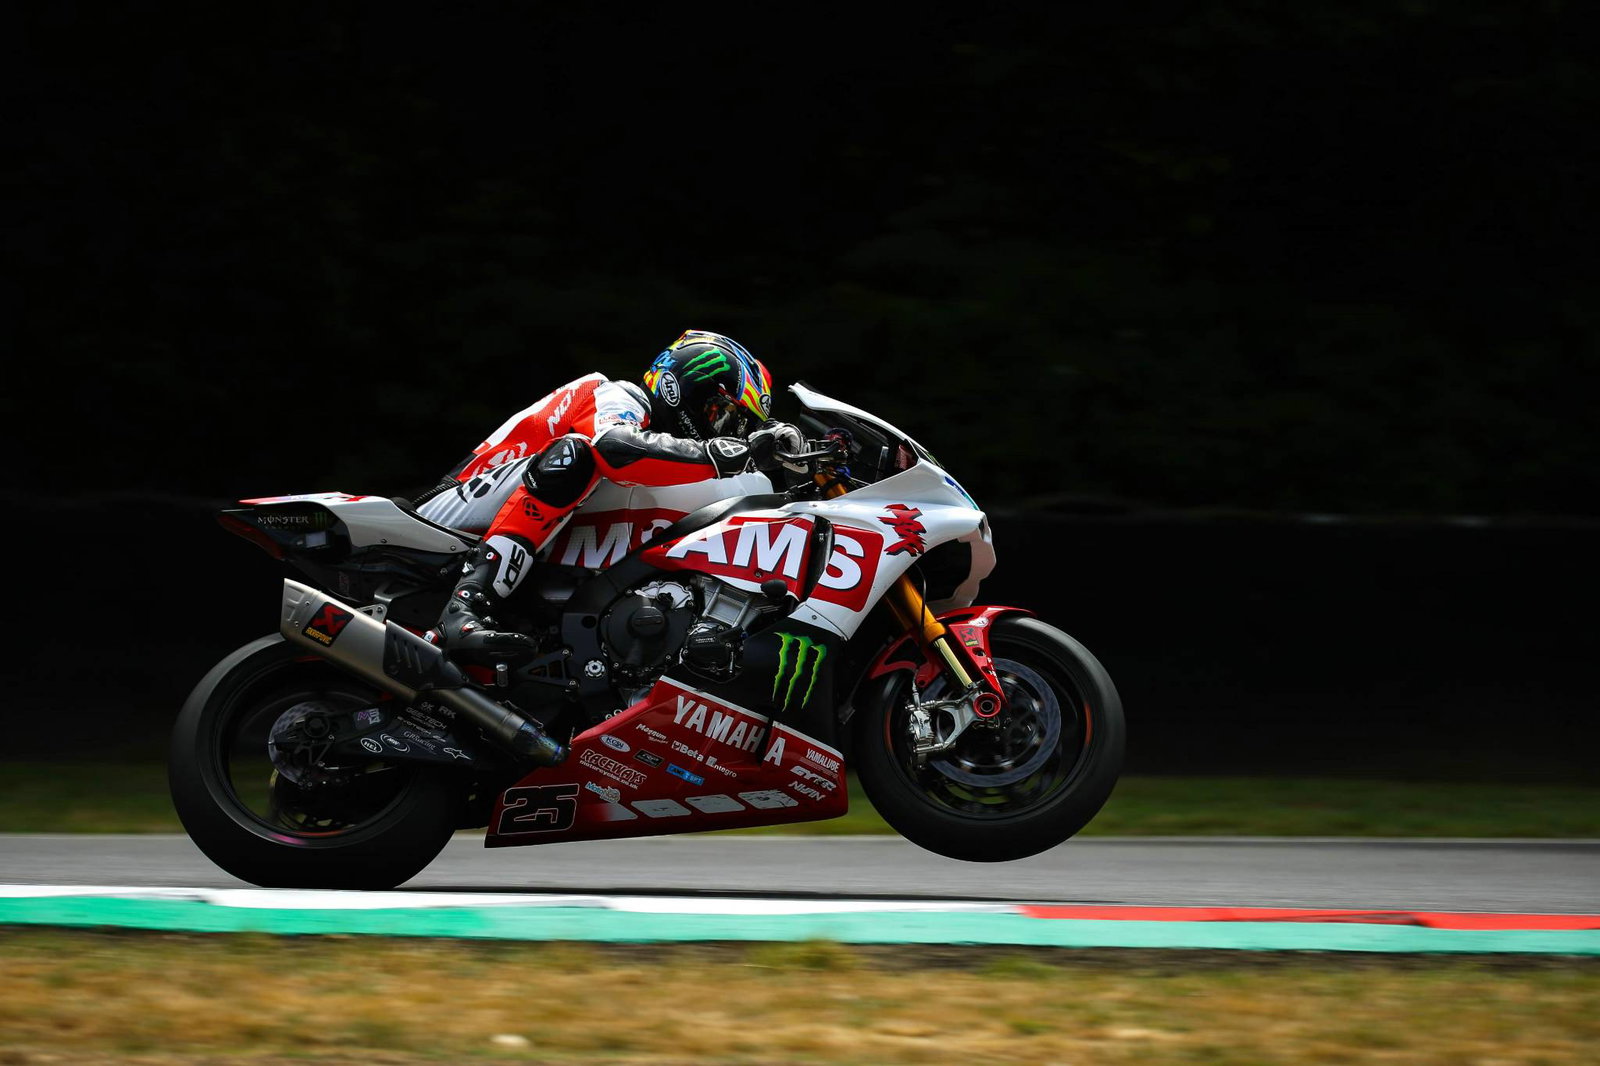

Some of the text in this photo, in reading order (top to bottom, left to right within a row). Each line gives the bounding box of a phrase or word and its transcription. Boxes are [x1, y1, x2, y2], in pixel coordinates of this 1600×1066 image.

[663, 374, 678, 402] Arai
[258, 515, 309, 525] MONSTER
[673, 695, 786, 767] YAMAHA
[580, 749, 647, 785] RACEWAYS
[680, 744, 704, 762] Beta
[805, 748, 841, 771] YAMALUBE
[497, 783, 580, 836] 25
